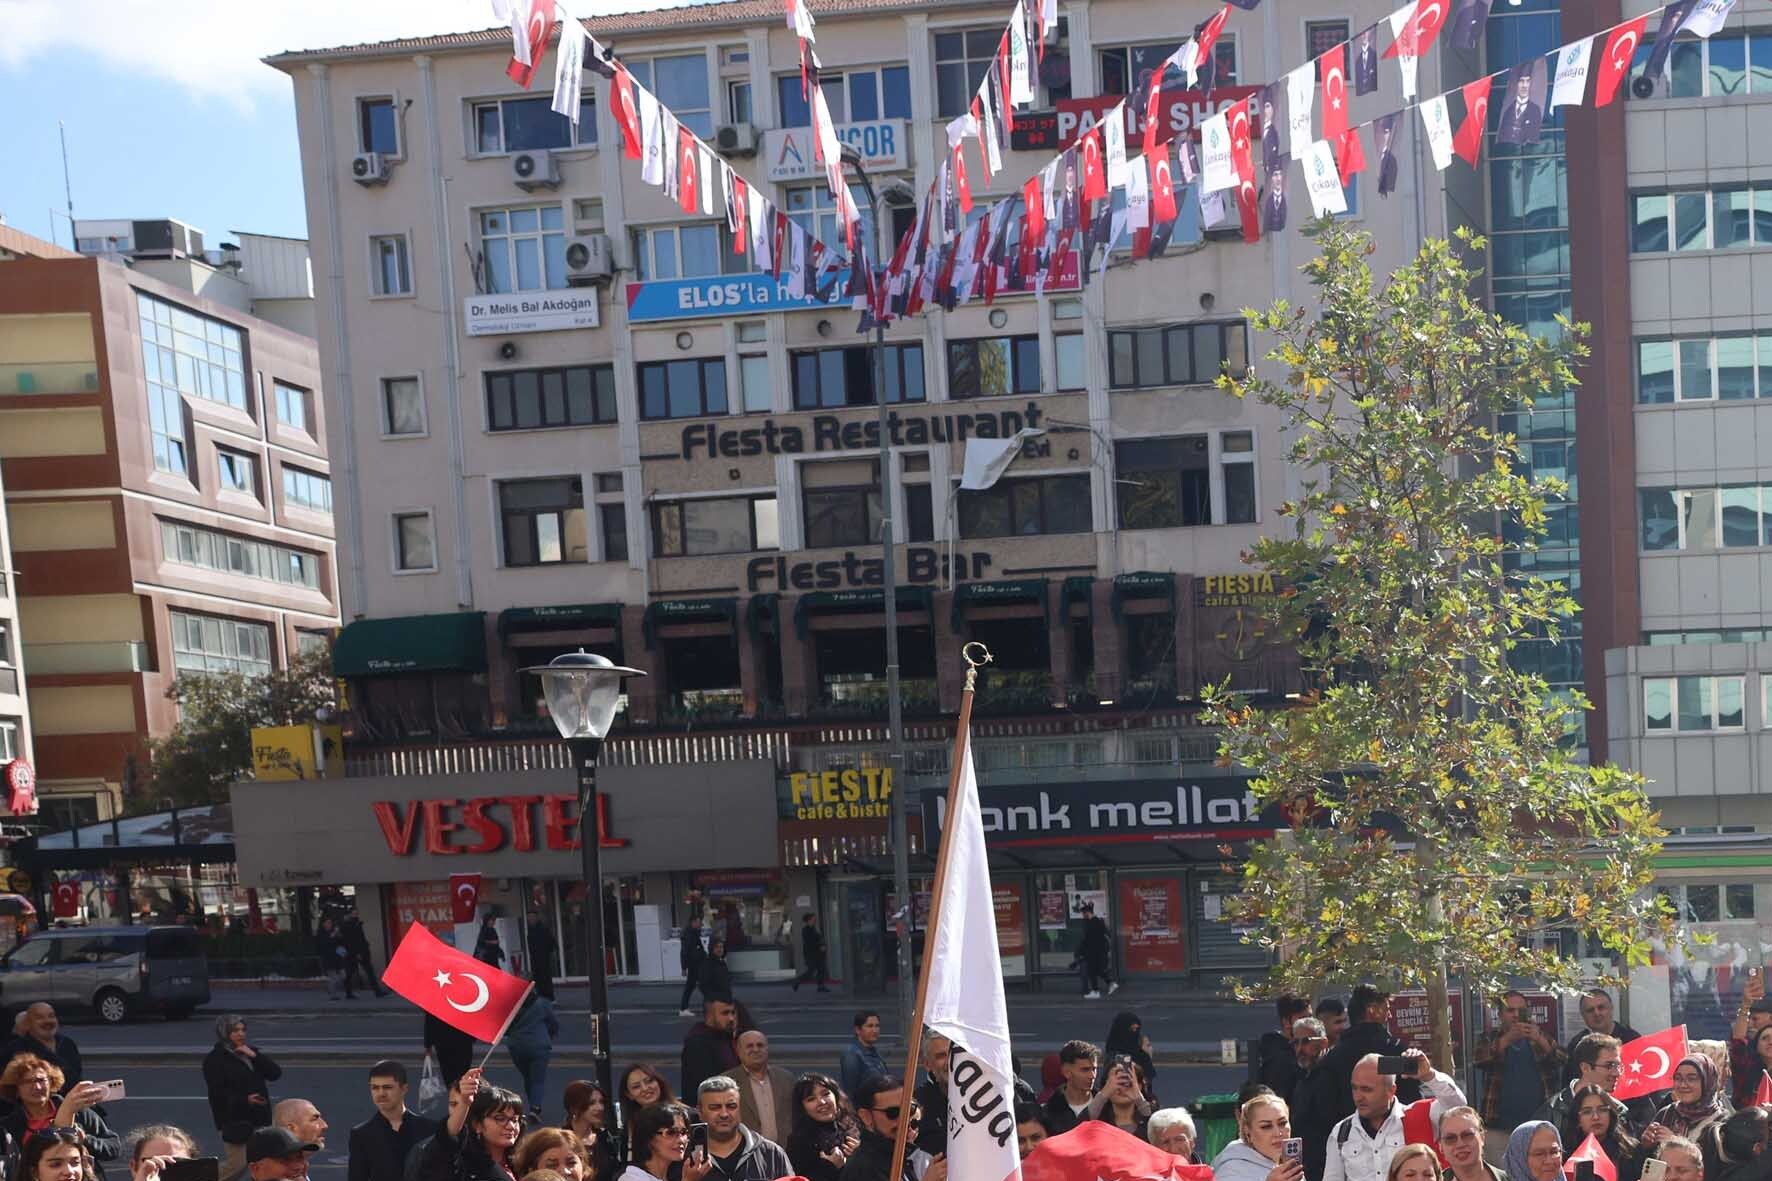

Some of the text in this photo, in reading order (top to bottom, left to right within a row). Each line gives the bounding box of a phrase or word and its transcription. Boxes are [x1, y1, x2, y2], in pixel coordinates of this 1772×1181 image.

[471, 297, 591, 317] Dr. Melis Bal Akdoğan
[813, 402, 1042, 452] Restaurant
[906, 549, 992, 585] Bar
[372, 792, 628, 856] VESTEL
[796, 804, 833, 821] cafe
[835, 802, 848, 820] &
[1089, 786, 1261, 828] mellat
